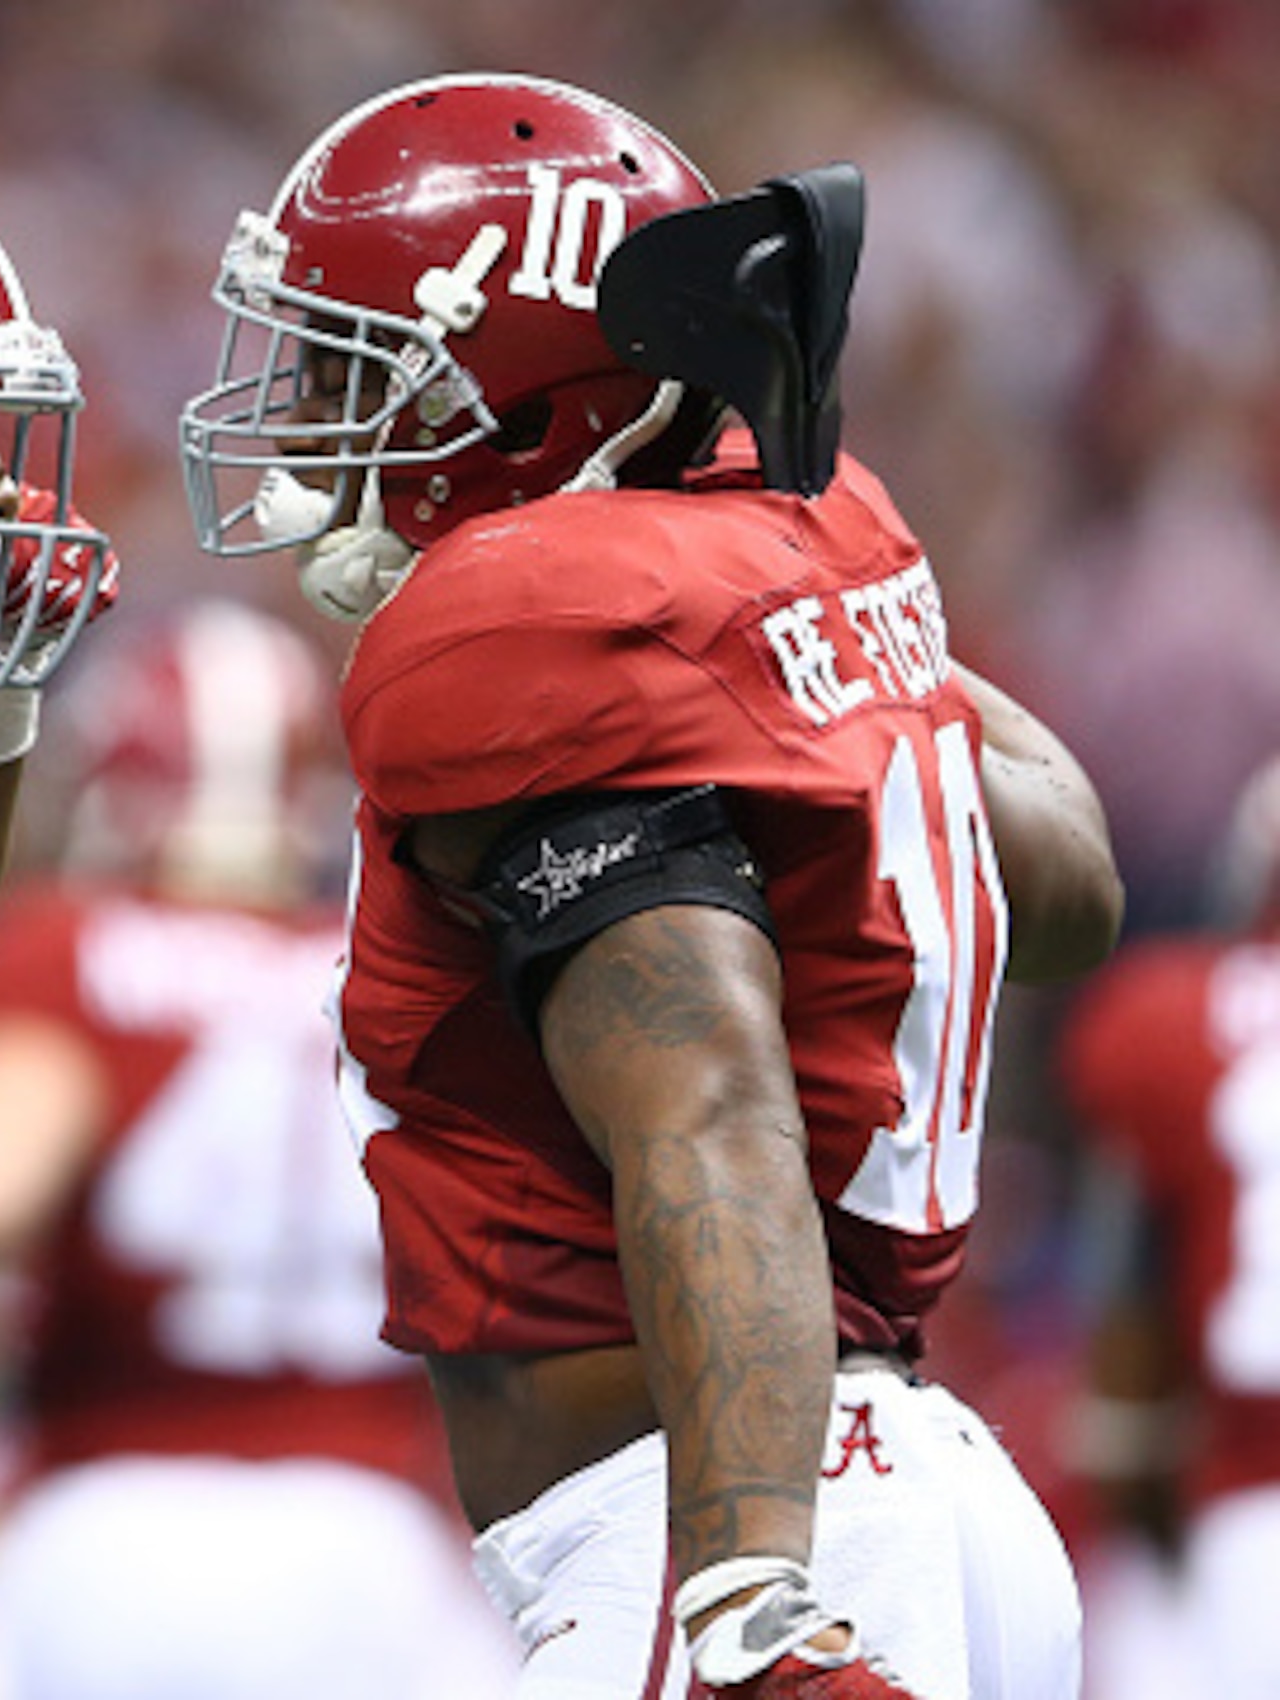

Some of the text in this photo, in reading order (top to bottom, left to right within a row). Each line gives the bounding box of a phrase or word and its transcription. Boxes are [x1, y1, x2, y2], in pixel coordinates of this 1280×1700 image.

[508, 163, 626, 309] 10
[837, 719, 1011, 1234] 10
[821, 1400, 894, 1478] A
